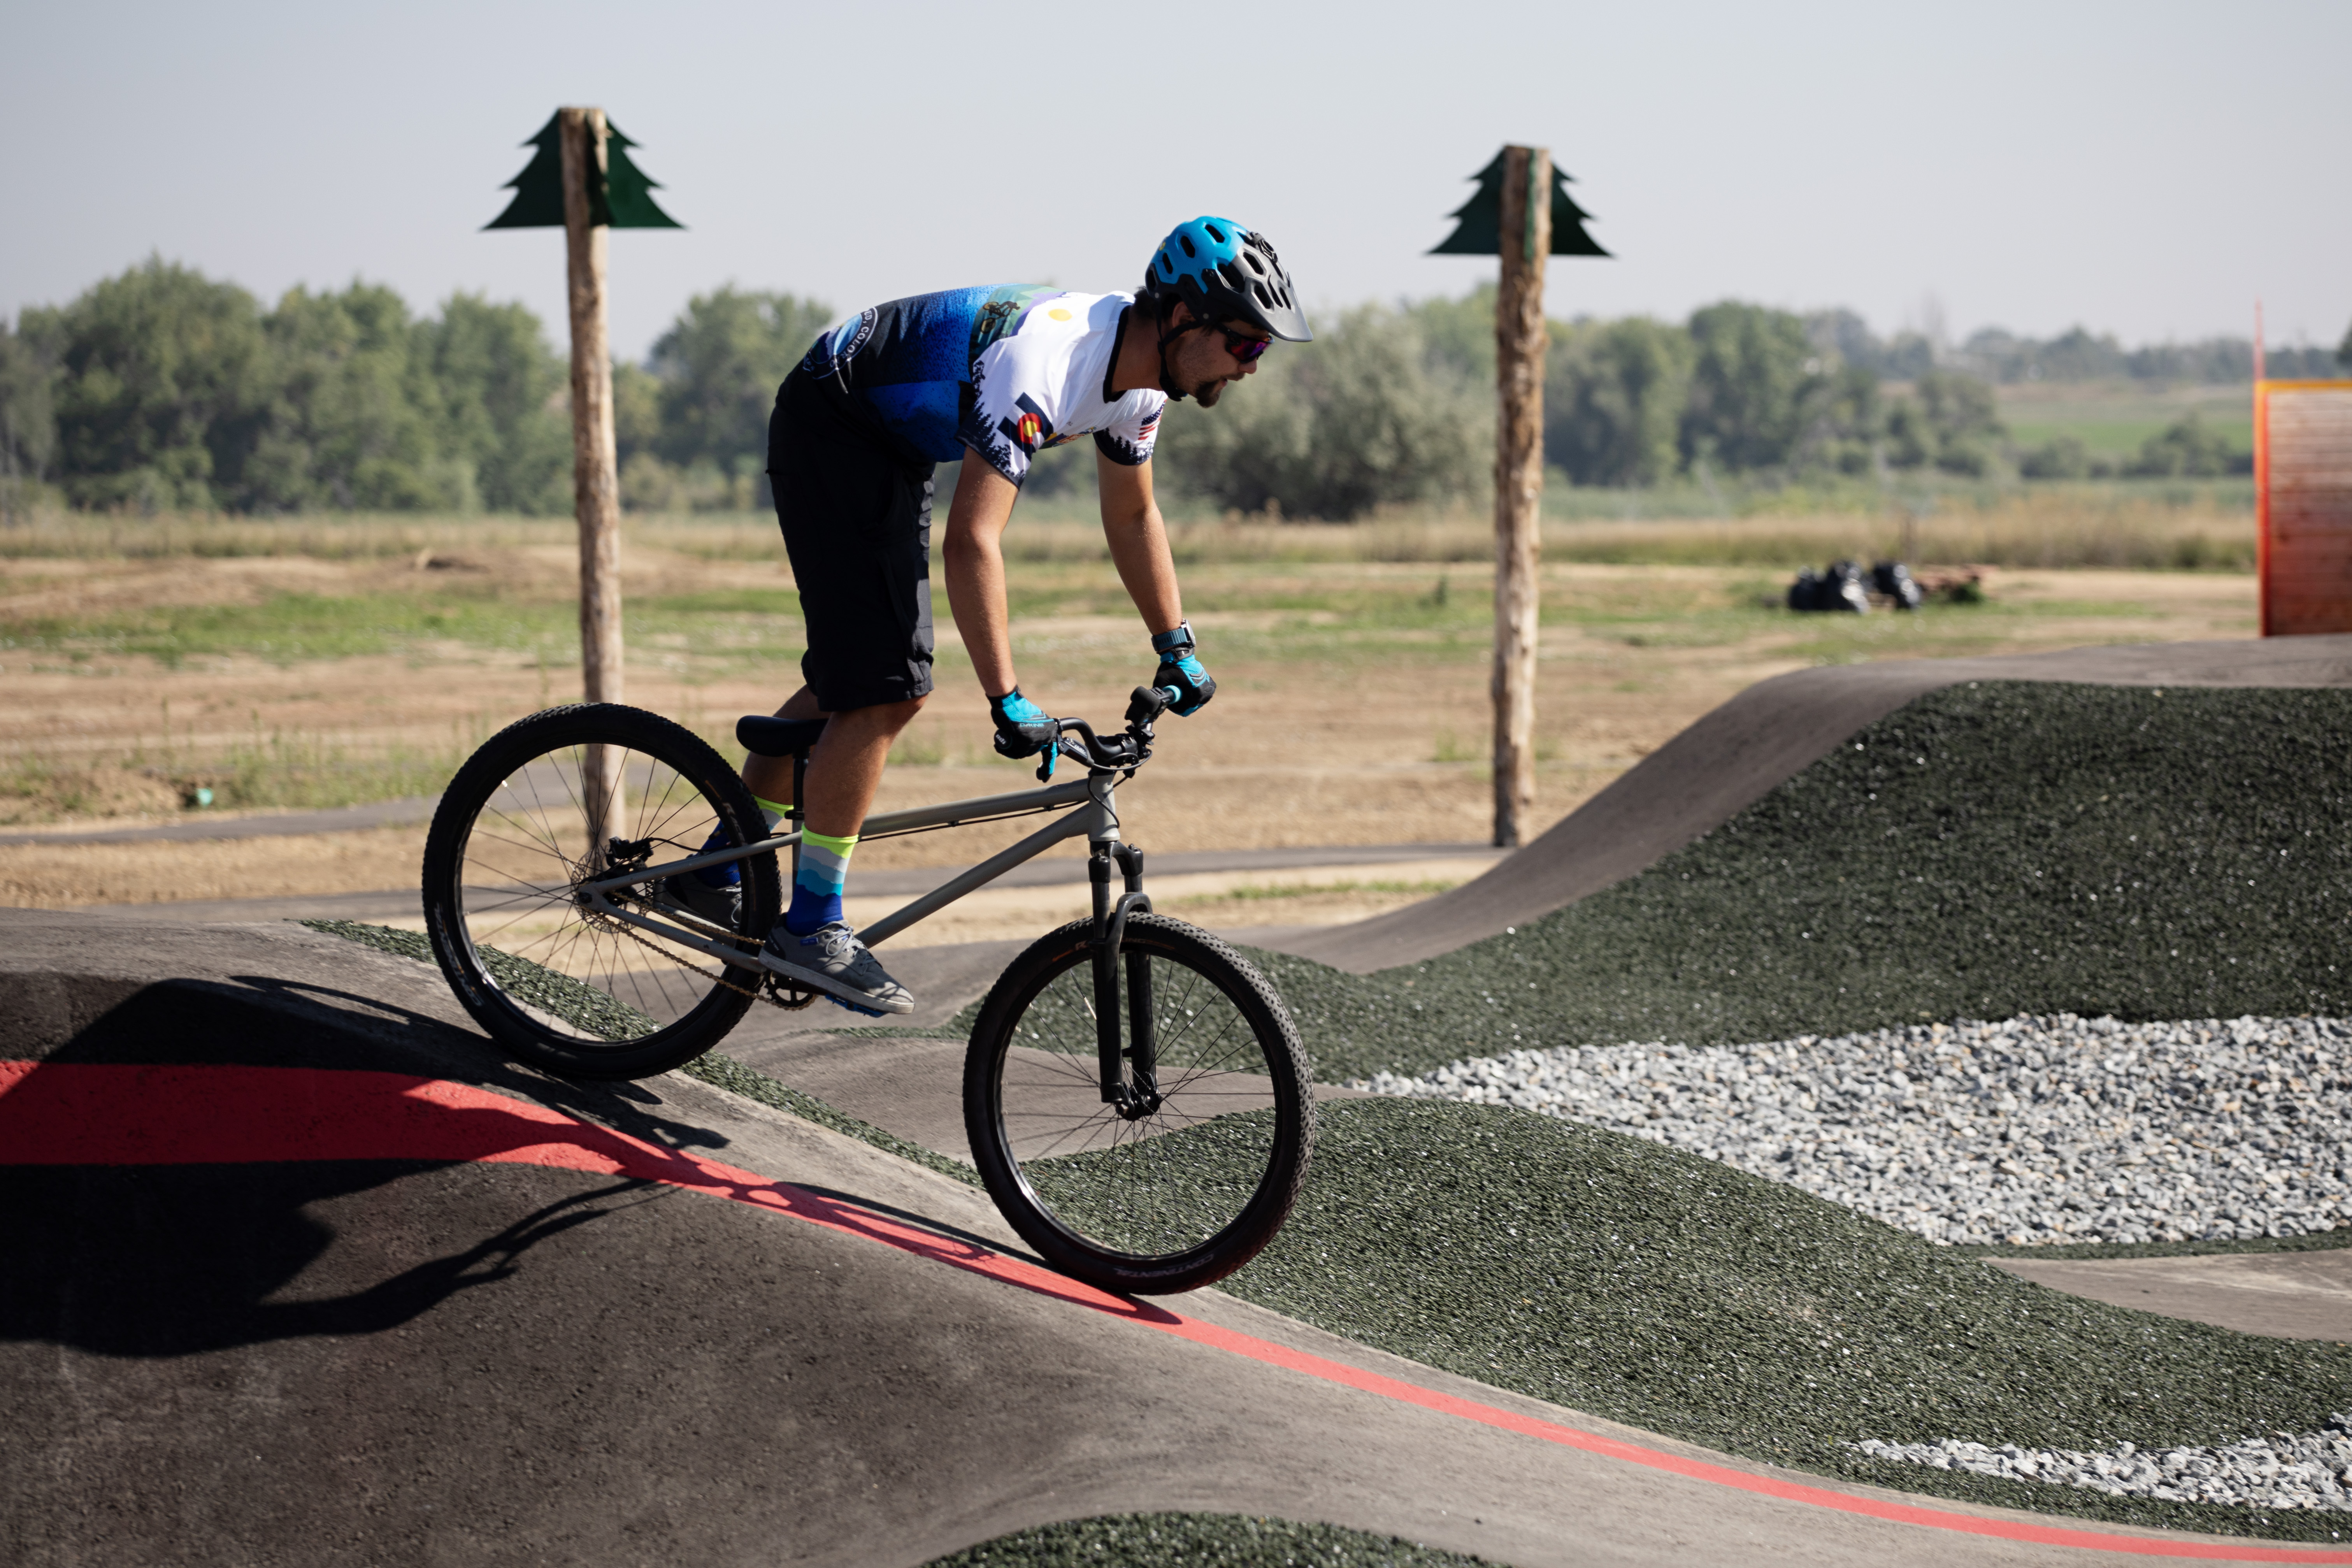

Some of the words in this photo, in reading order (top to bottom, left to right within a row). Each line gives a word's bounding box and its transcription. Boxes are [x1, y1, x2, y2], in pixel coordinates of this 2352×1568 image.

[830, 326, 869, 367] COLORO
[434, 902, 483, 1006] CONTINENTAL
[1113, 1254, 1215, 1277] CONTINENTAL
